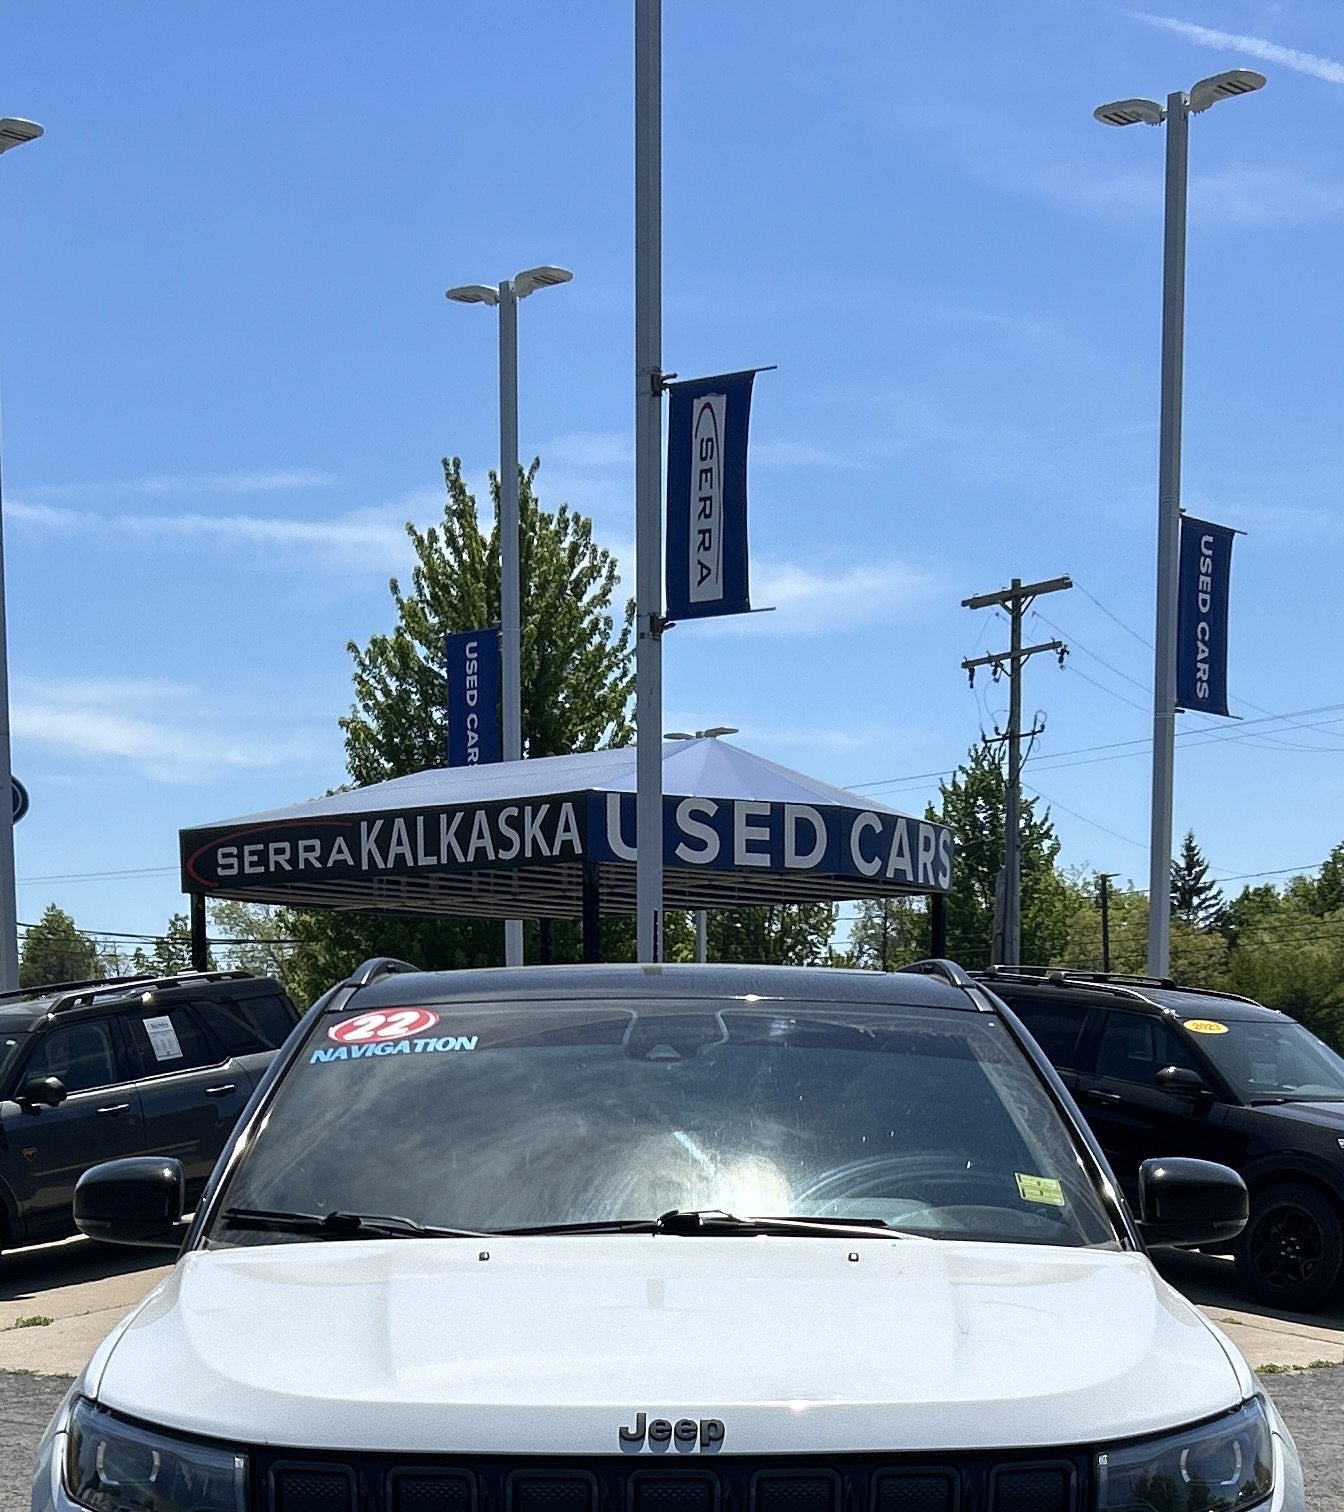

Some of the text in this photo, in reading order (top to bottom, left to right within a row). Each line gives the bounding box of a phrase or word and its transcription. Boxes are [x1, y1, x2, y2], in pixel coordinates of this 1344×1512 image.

[697, 437, 714, 588] SERRA
[1196, 534, 1214, 699] USED CARS
[465, 641, 479, 766] USED CAR
[217, 802, 583, 877] SERRA KALKASKA
[850, 812, 951, 890] CARS
[309, 1035, 478, 1065] NAVIGATION
[342, 1009, 421, 1040] 22
[618, 1412, 725, 1447] Jeep
